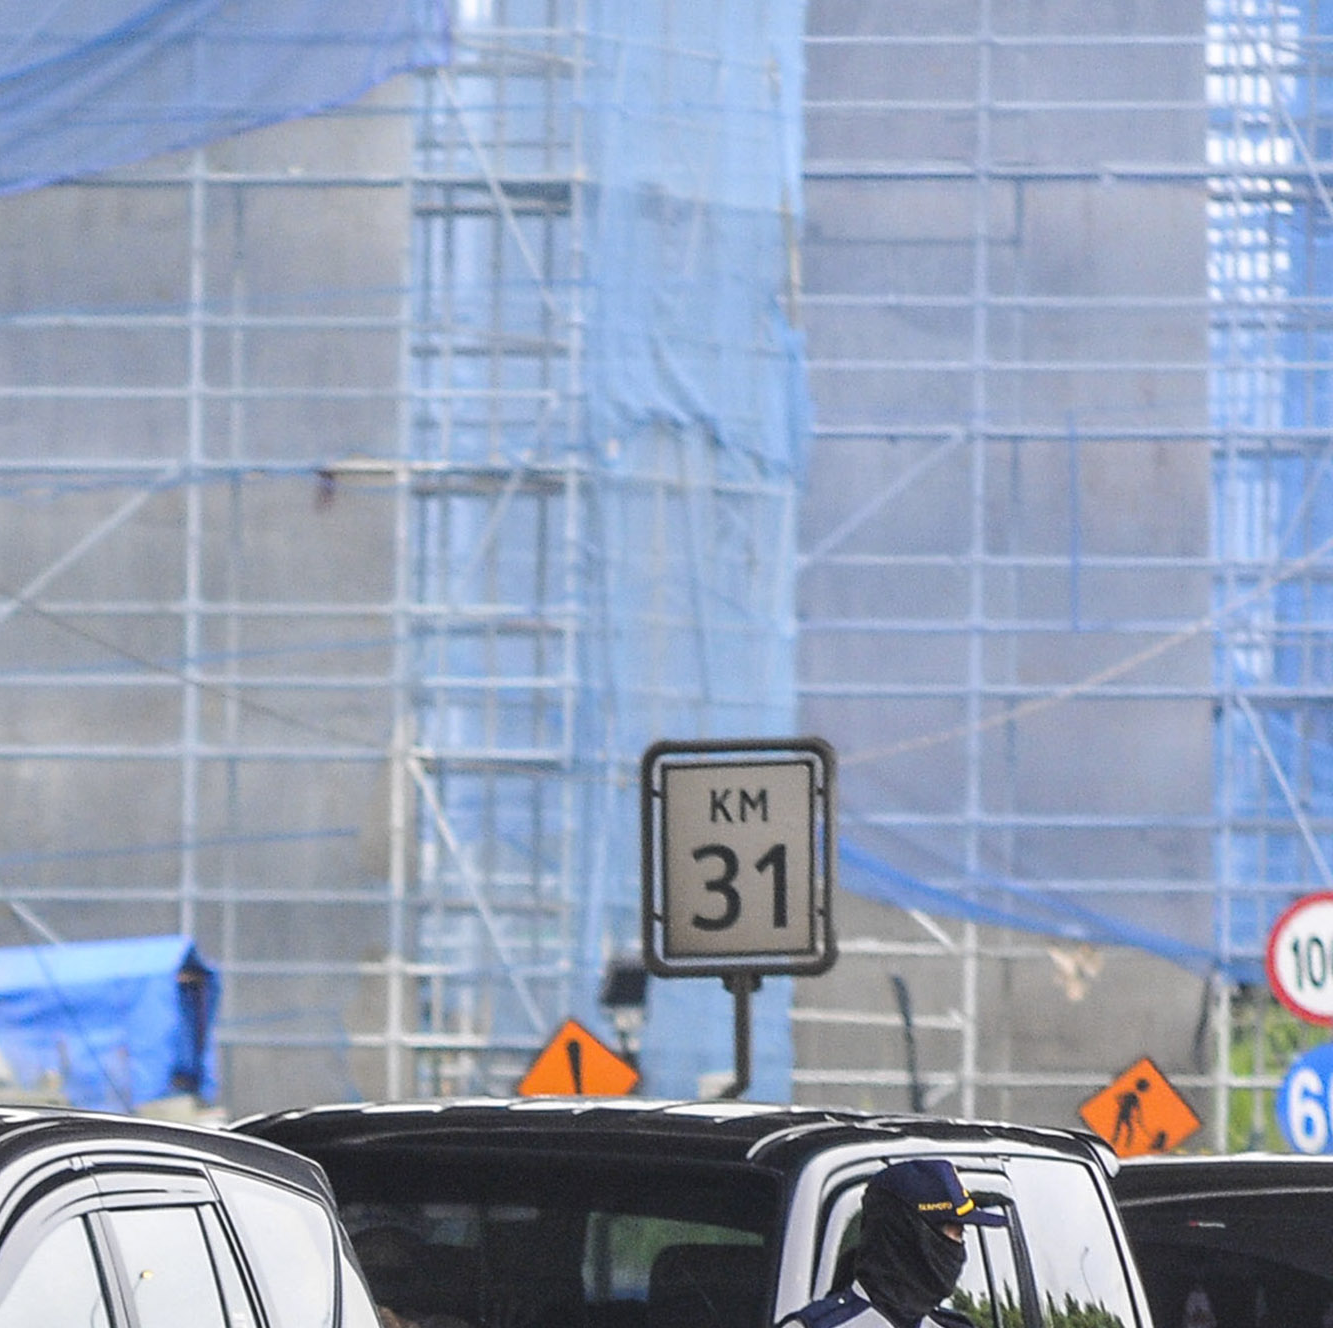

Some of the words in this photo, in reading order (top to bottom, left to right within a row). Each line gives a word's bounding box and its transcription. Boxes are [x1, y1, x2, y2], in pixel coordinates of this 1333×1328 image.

[710, 788, 768, 823] KM
[692, 843, 788, 932] 31
[1293, 936, 1333, 991] 10
[1289, 1068, 1333, 1154] 6
